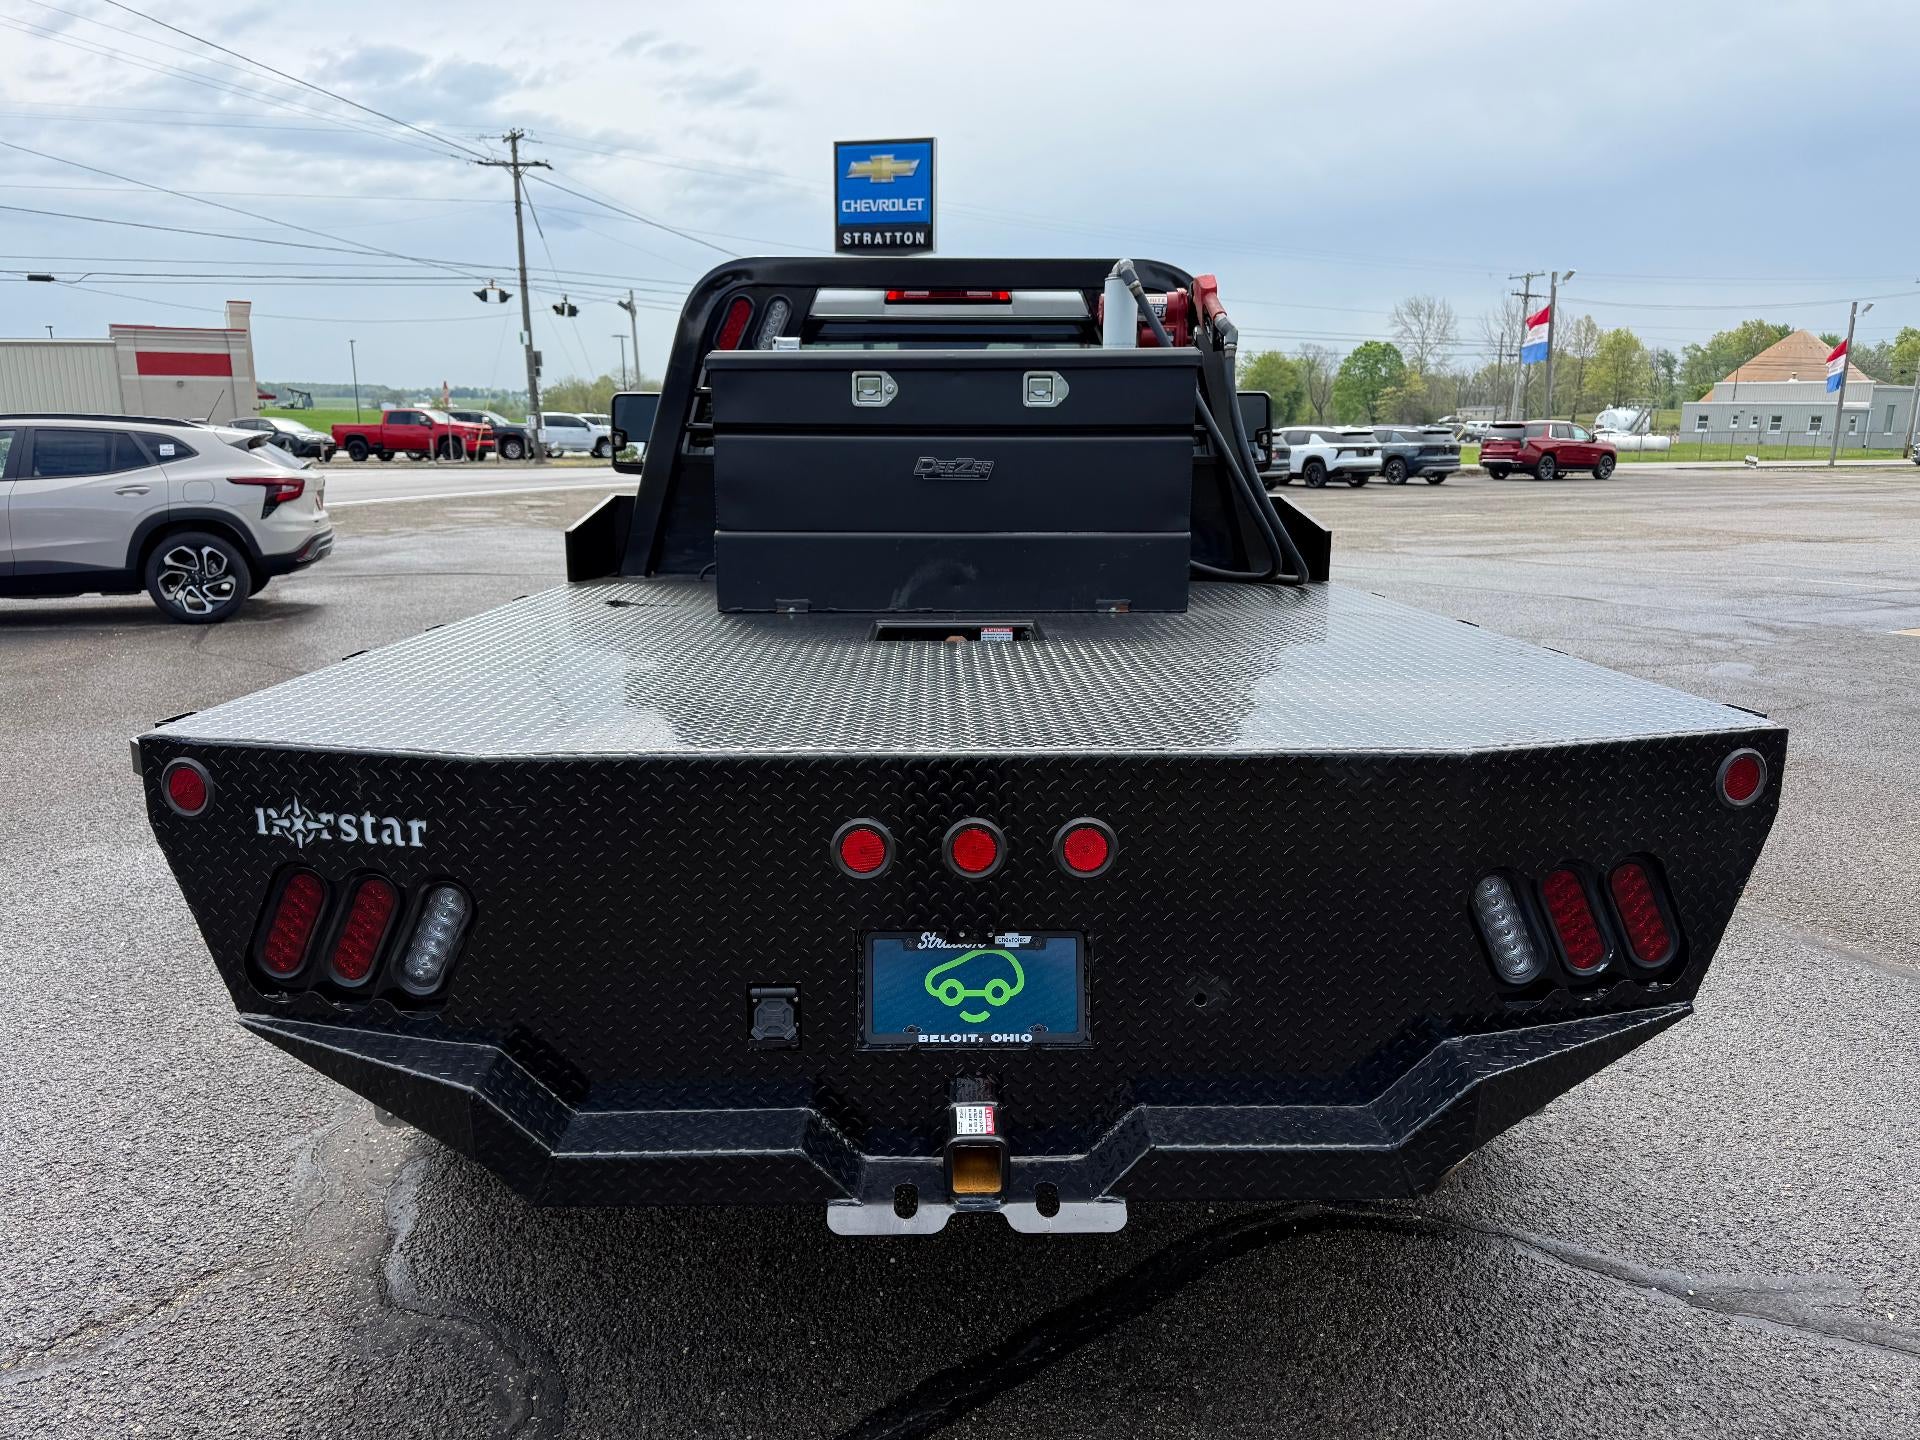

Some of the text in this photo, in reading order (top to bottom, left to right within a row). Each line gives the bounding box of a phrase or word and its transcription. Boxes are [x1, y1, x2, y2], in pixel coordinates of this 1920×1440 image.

[841, 198, 925, 213] CHEVROLET
[843, 231, 925, 245] STRATTON
[918, 1033, 1033, 1043] BELOIT, OHIO
